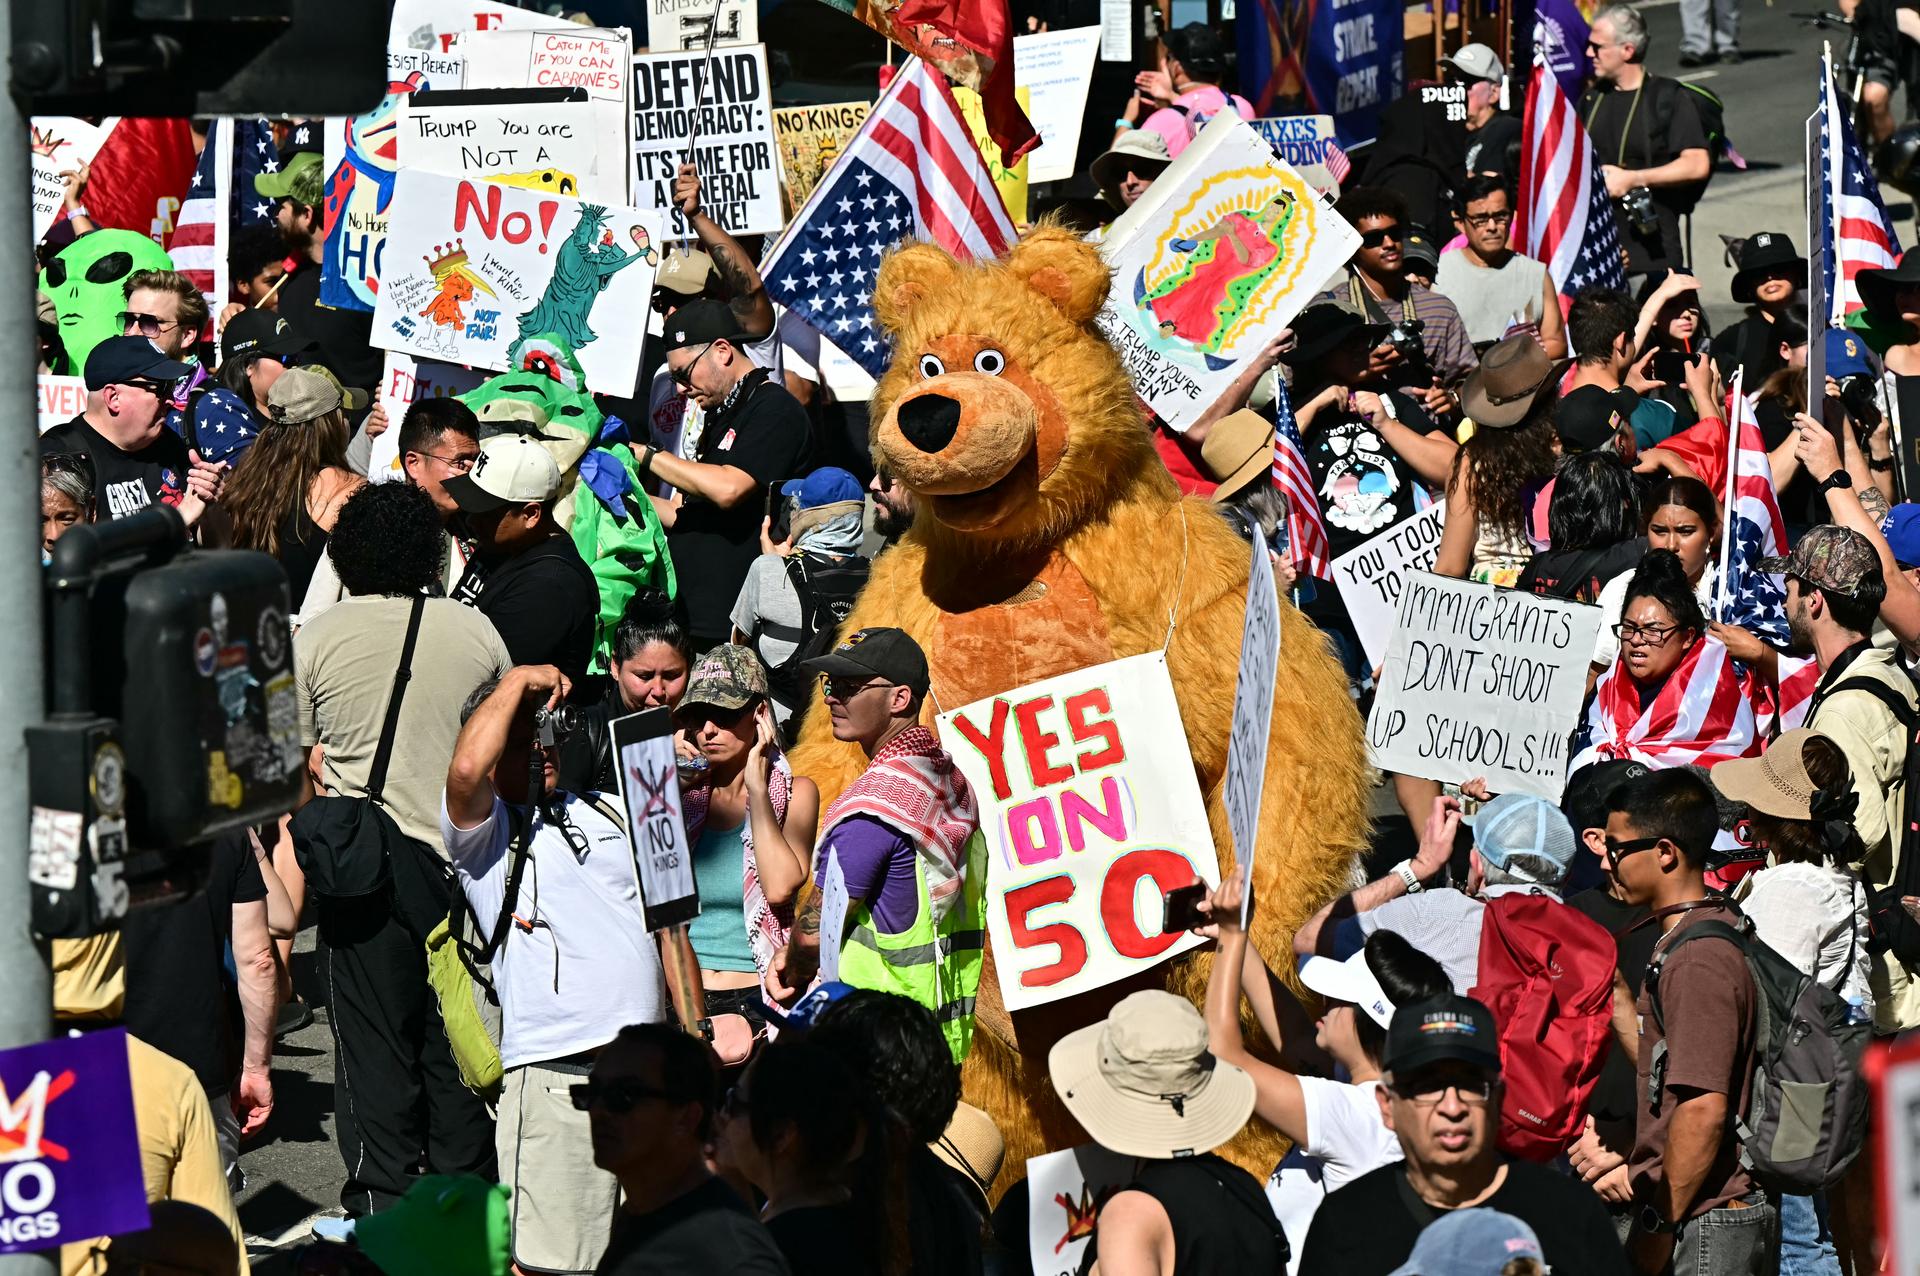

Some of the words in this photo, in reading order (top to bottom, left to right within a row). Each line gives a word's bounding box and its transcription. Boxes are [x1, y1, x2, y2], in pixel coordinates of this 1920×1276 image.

[387, 53, 418, 71] ESIST
[421, 52, 461, 75] REPEAT
[534, 53, 549, 65] IF
[551, 55, 573, 66] YOU
[578, 56, 614, 69] CAN
[537, 69, 621, 90] CABRONES
[633, 52, 761, 112] DEFEND
[408, 115, 477, 138] TRUMP
[538, 123, 573, 139] are
[635, 103, 765, 142] DEMOCRACY:
[777, 112, 802, 135] NO
[461, 145, 518, 170] NOT
[536, 146, 551, 163] A
[636, 150, 675, 182] IT'S
[730, 141, 771, 174] FOR
[654, 180, 668, 209] A
[474, 309, 502, 324] NOT
[1120, 321, 1162, 363] TRUMP
[1161, 361, 1202, 401] YOU'RE
[1128, 349, 1158, 379] WITH
[1155, 374, 1178, 396] MY
[390, 367, 433, 404] FDT
[1343, 547, 1385, 585] YOU
[1386, 509, 1444, 558] TOOK
[1400, 579, 1572, 649] IMMIGRANTS
[1402, 640, 1484, 693] DONT
[1484, 652, 1560, 703] SHOOT
[951, 686, 1128, 802] YES
[1372, 706, 1406, 749] UP
[1418, 712, 1562, 777] SCHOOLS!!!
[648, 817, 675, 855] NO
[1006, 776, 1128, 867] ON
[653, 852, 679, 873] KINGS
[1003, 845, 1198, 988] 50
[0, 1161, 56, 1216] O
